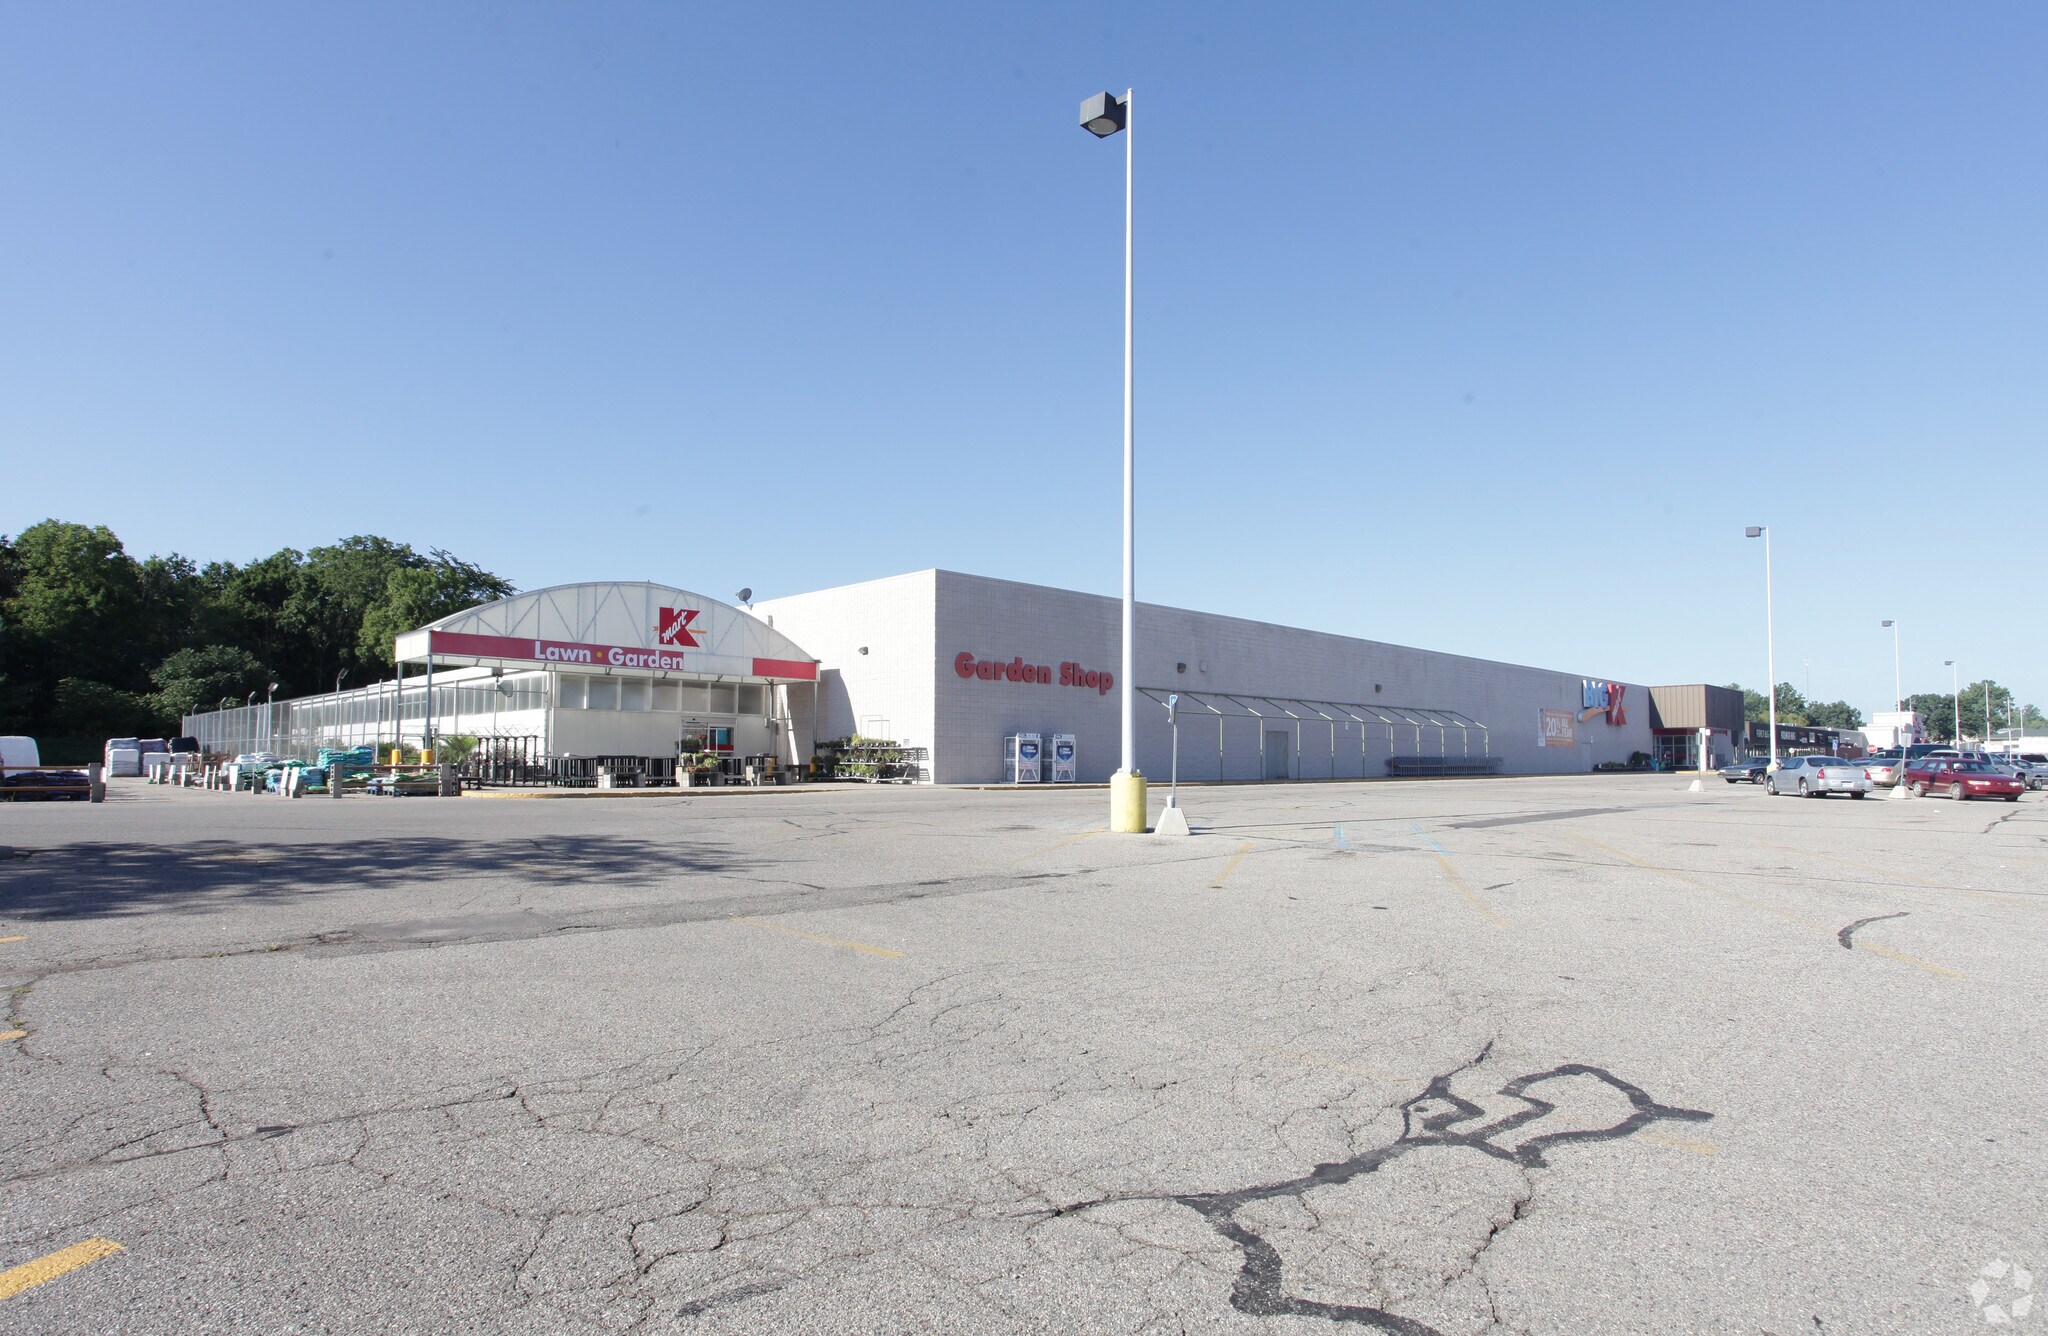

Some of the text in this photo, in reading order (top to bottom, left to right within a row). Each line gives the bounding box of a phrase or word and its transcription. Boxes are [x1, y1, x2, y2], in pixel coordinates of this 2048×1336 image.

[534, 640, 684, 670] Lawn Garden
[954, 651, 1114, 696] Garden Shop
